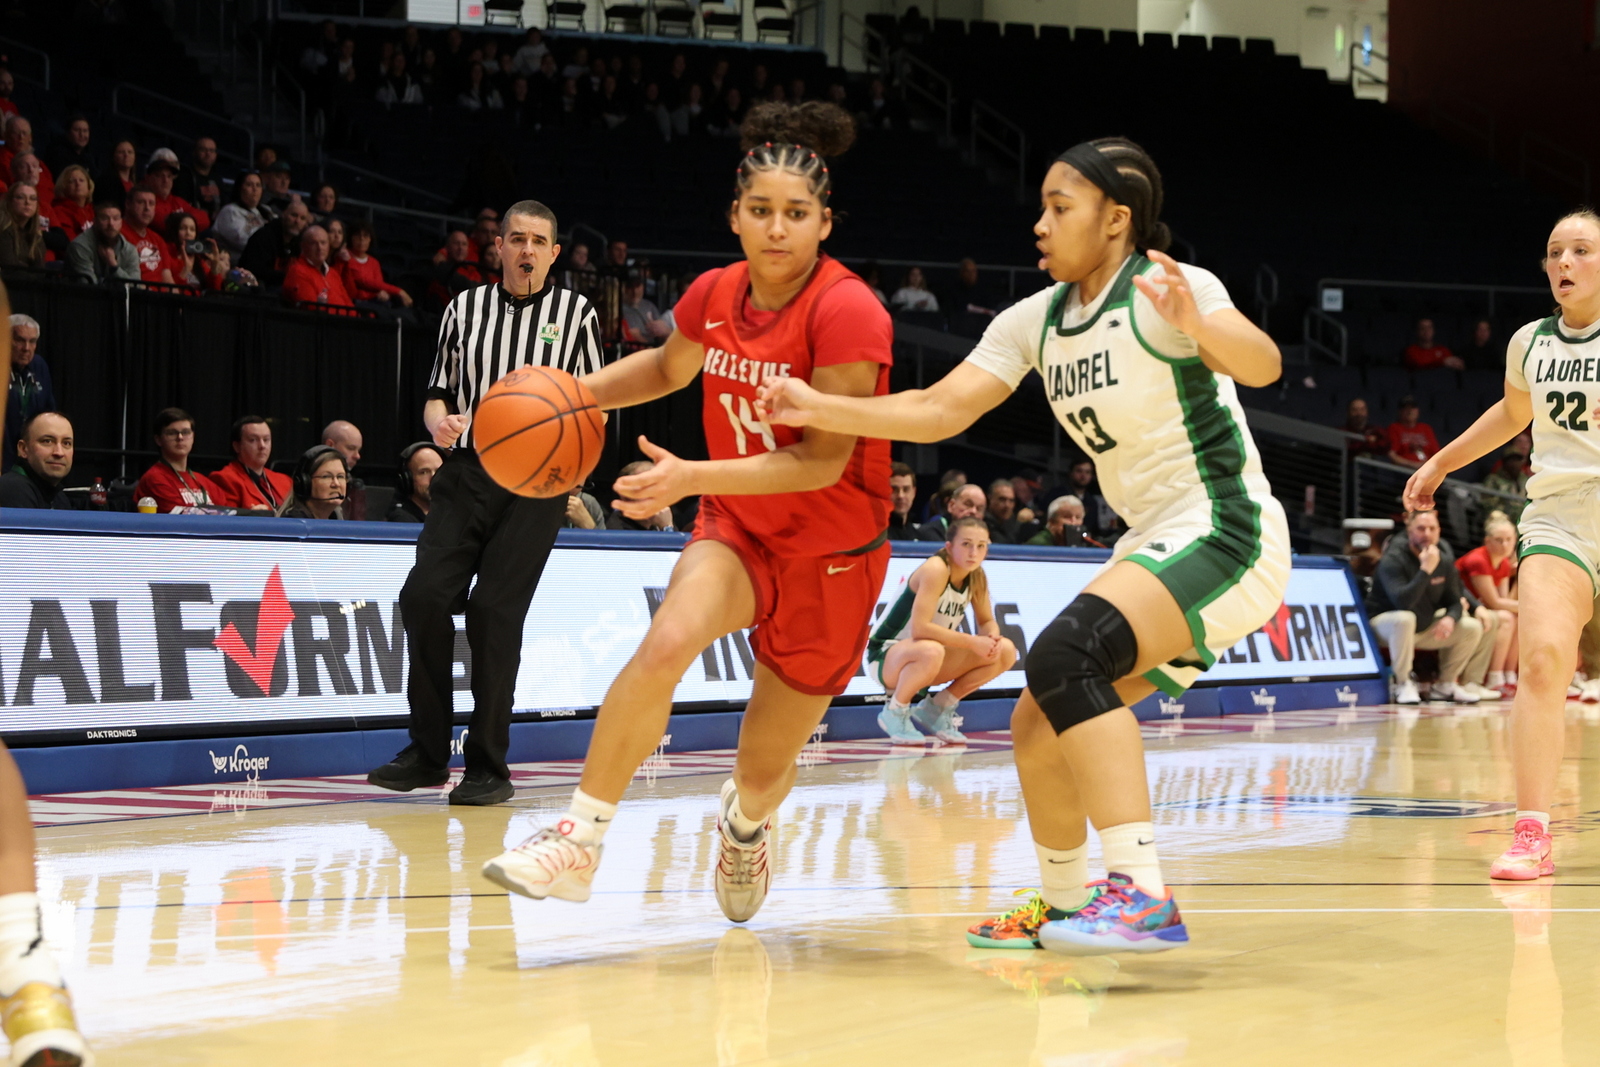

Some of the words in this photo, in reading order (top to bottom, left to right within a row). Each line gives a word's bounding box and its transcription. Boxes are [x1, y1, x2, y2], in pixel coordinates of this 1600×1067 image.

[703, 347, 791, 387] BELLEVUE
[1048, 349, 1119, 402] LAUREL
[718, 392, 777, 456] 14
[1066, 406, 1118, 454] 13
[1546, 391, 1589, 431] 22
[937, 600, 966, 617] LAUR
[86, 729, 137, 739] DAKTRONICS
[229, 744, 270, 782] Kroger
